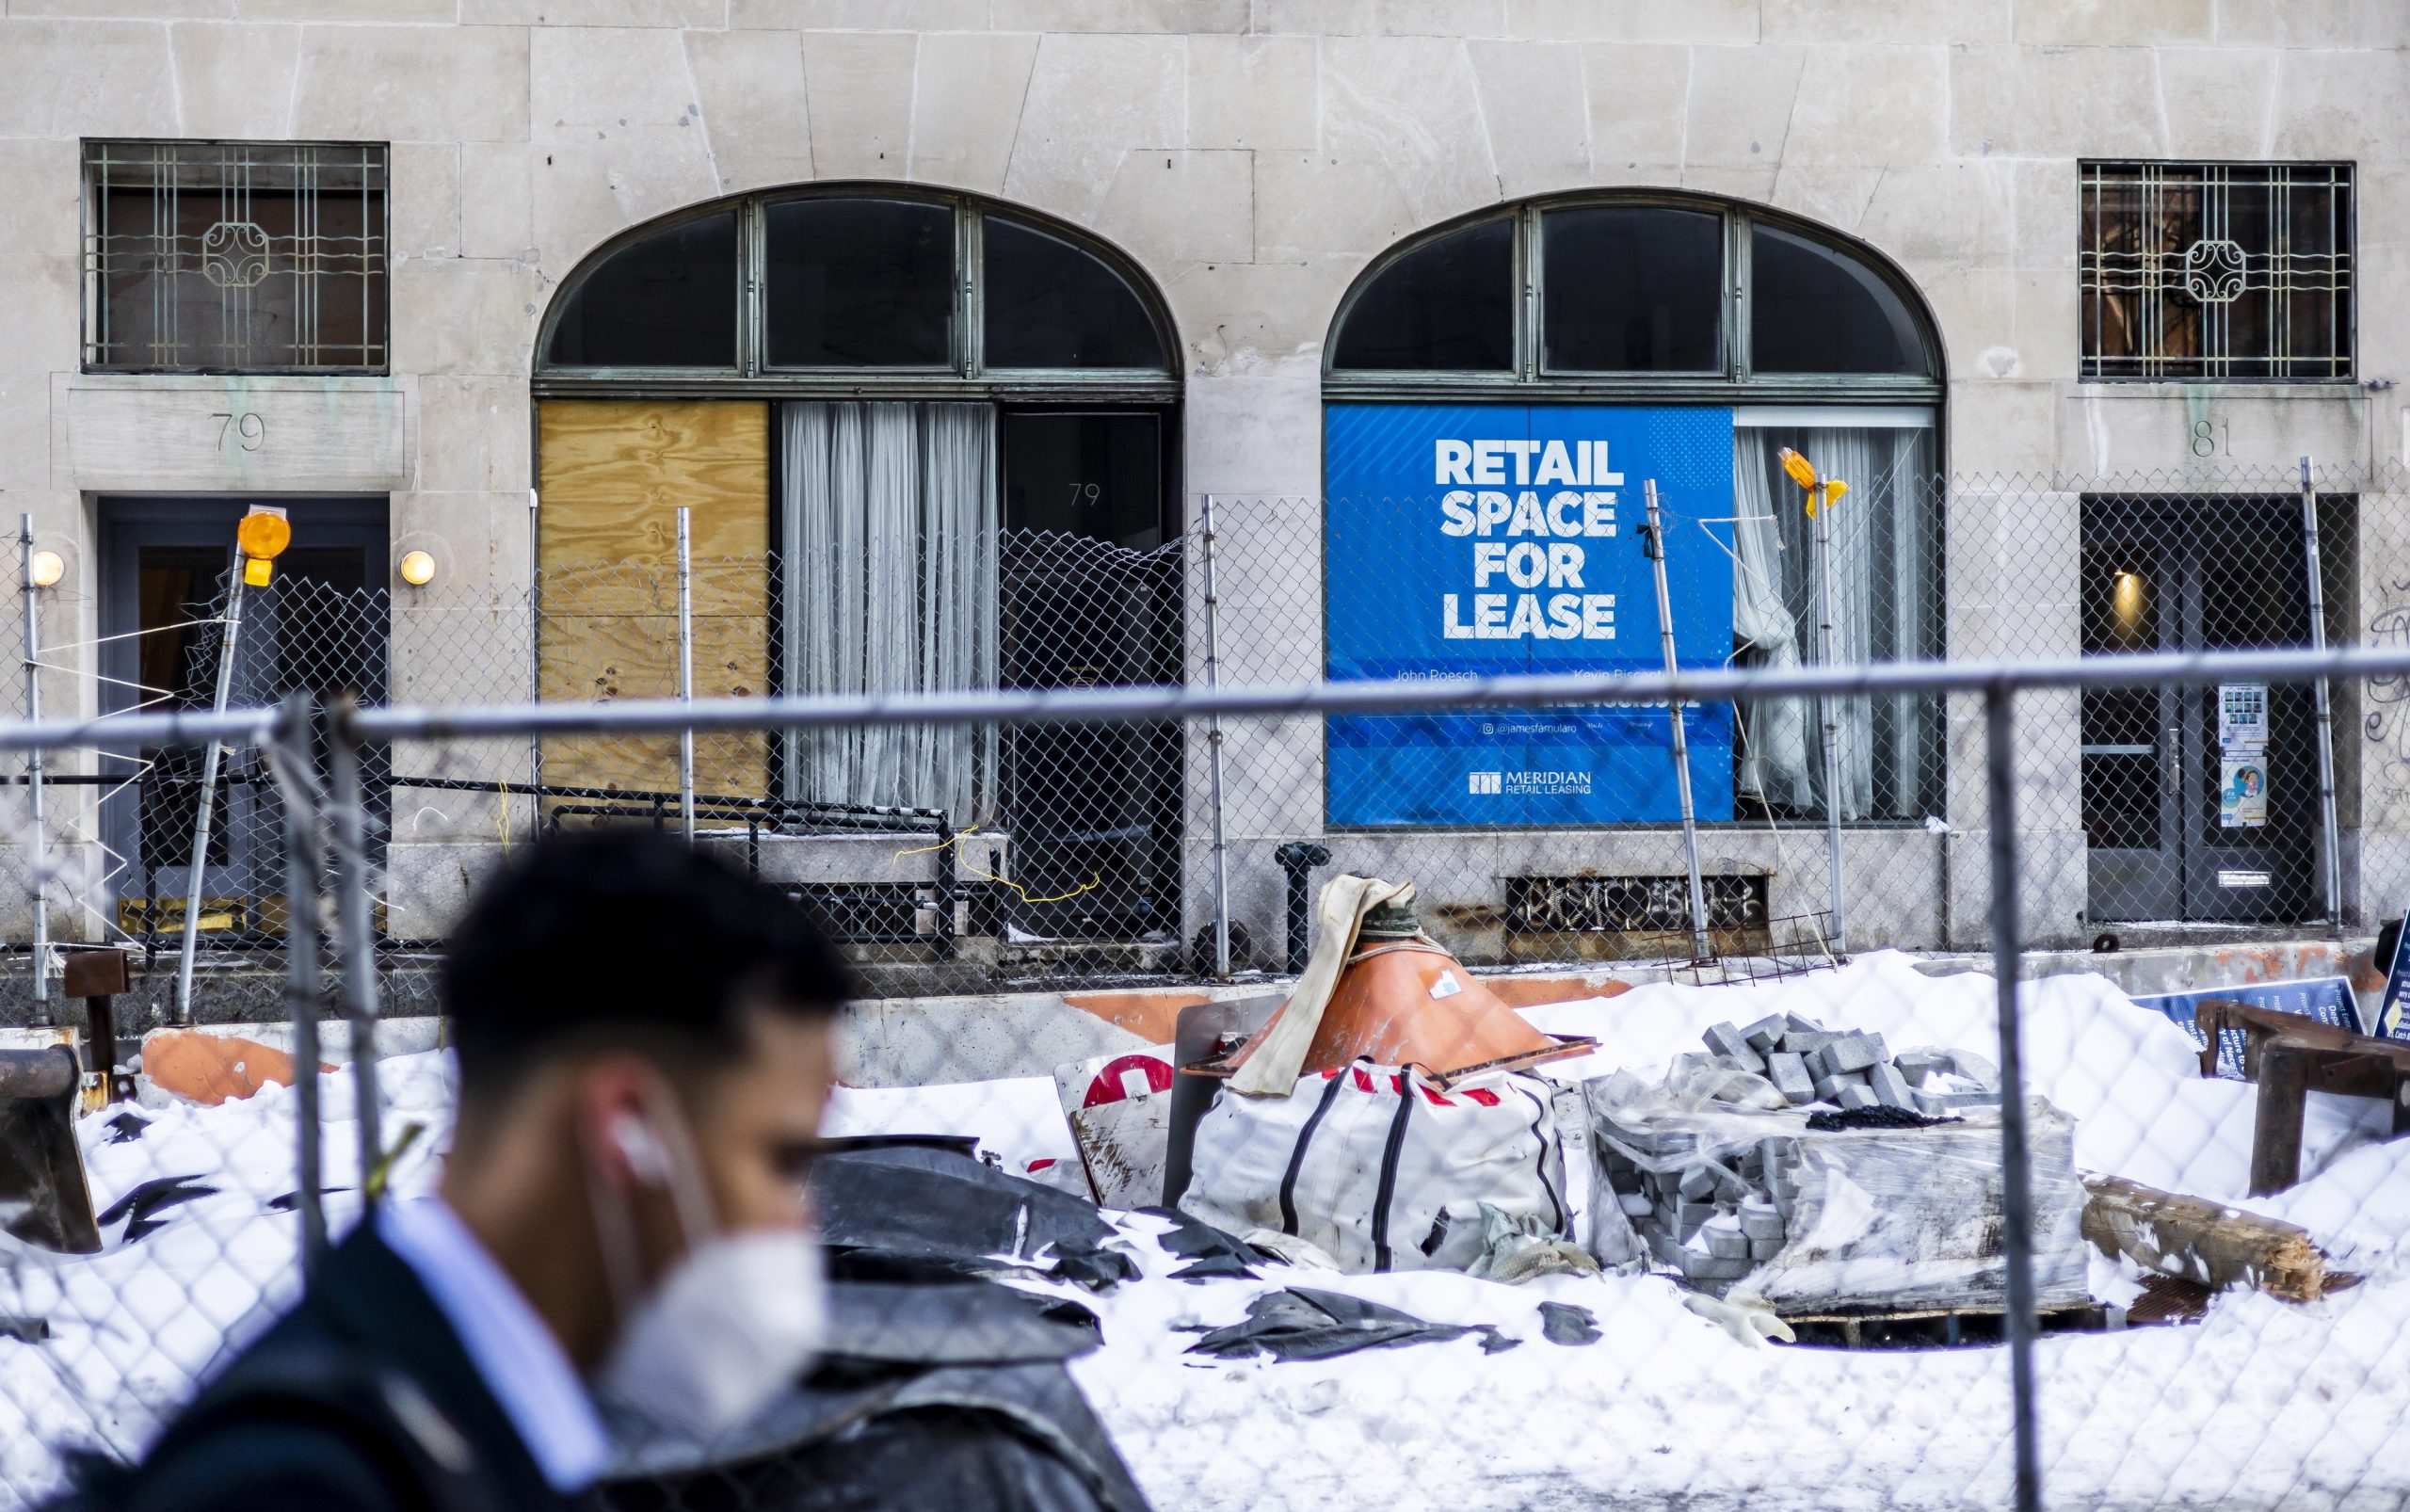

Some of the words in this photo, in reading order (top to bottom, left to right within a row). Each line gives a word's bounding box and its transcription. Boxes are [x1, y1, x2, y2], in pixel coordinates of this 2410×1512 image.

[208, 411, 265, 452] 79
[2192, 417, 2232, 458] 81
[1436, 439, 1624, 486] RETAIL
[1068, 483, 1101, 507] 79
[1440, 490, 1617, 538] SPACE
[1474, 541, 1585, 588] FOR
[1443, 593, 1616, 640] LEASE
[1393, 669, 1426, 682] John
[1430, 669, 1478, 682] Roesch
[1497, 723, 1577, 735] @jamesfamularo
[1506, 771, 1591, 785] MERIDIAN
[1506, 785, 1542, 795] RETAIL
[1545, 785, 1591, 795] LEASING
[2328, 1005, 2340, 1026] Depa
